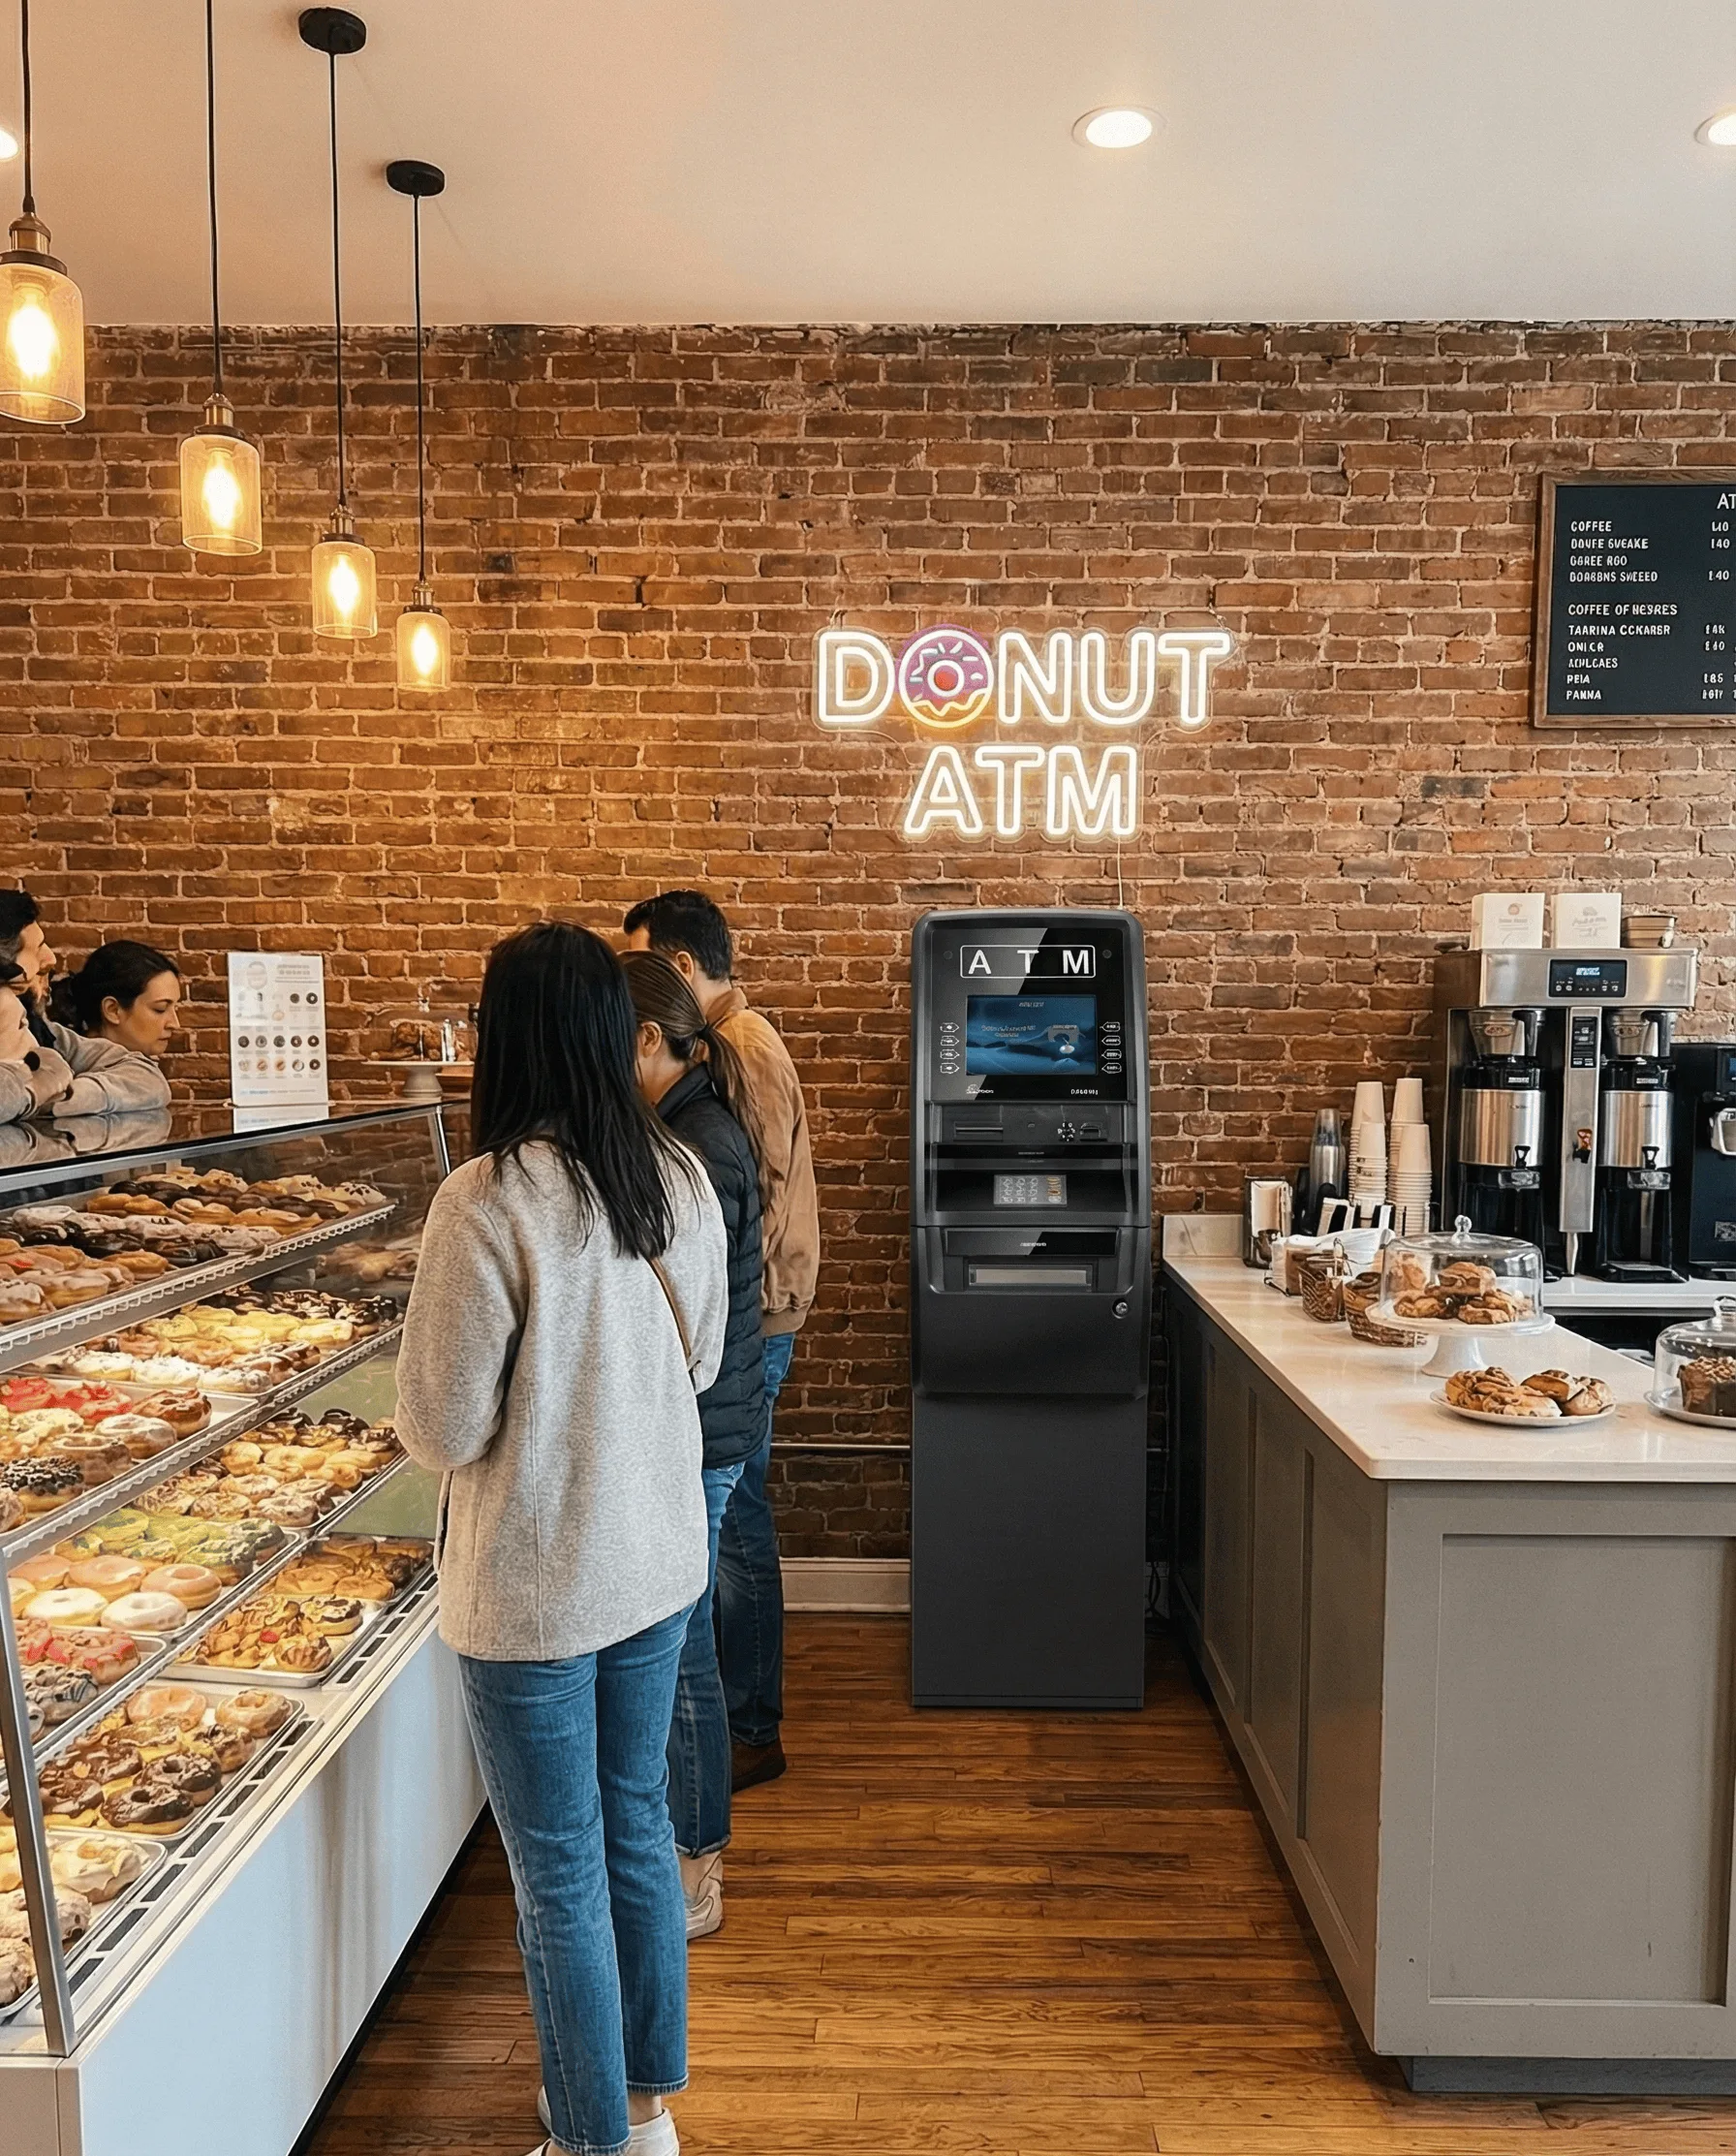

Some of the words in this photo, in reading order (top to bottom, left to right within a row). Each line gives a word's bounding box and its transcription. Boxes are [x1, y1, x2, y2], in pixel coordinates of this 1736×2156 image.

[1570, 520, 1612, 532] COFFEE
[1567, 604, 1610, 615] COFFEE
[1614, 604, 1630, 615] OF
[818, 628, 1231, 729] DONUT
[903, 743, 1138, 836] ATM
[968, 949, 1091, 975] ATM
